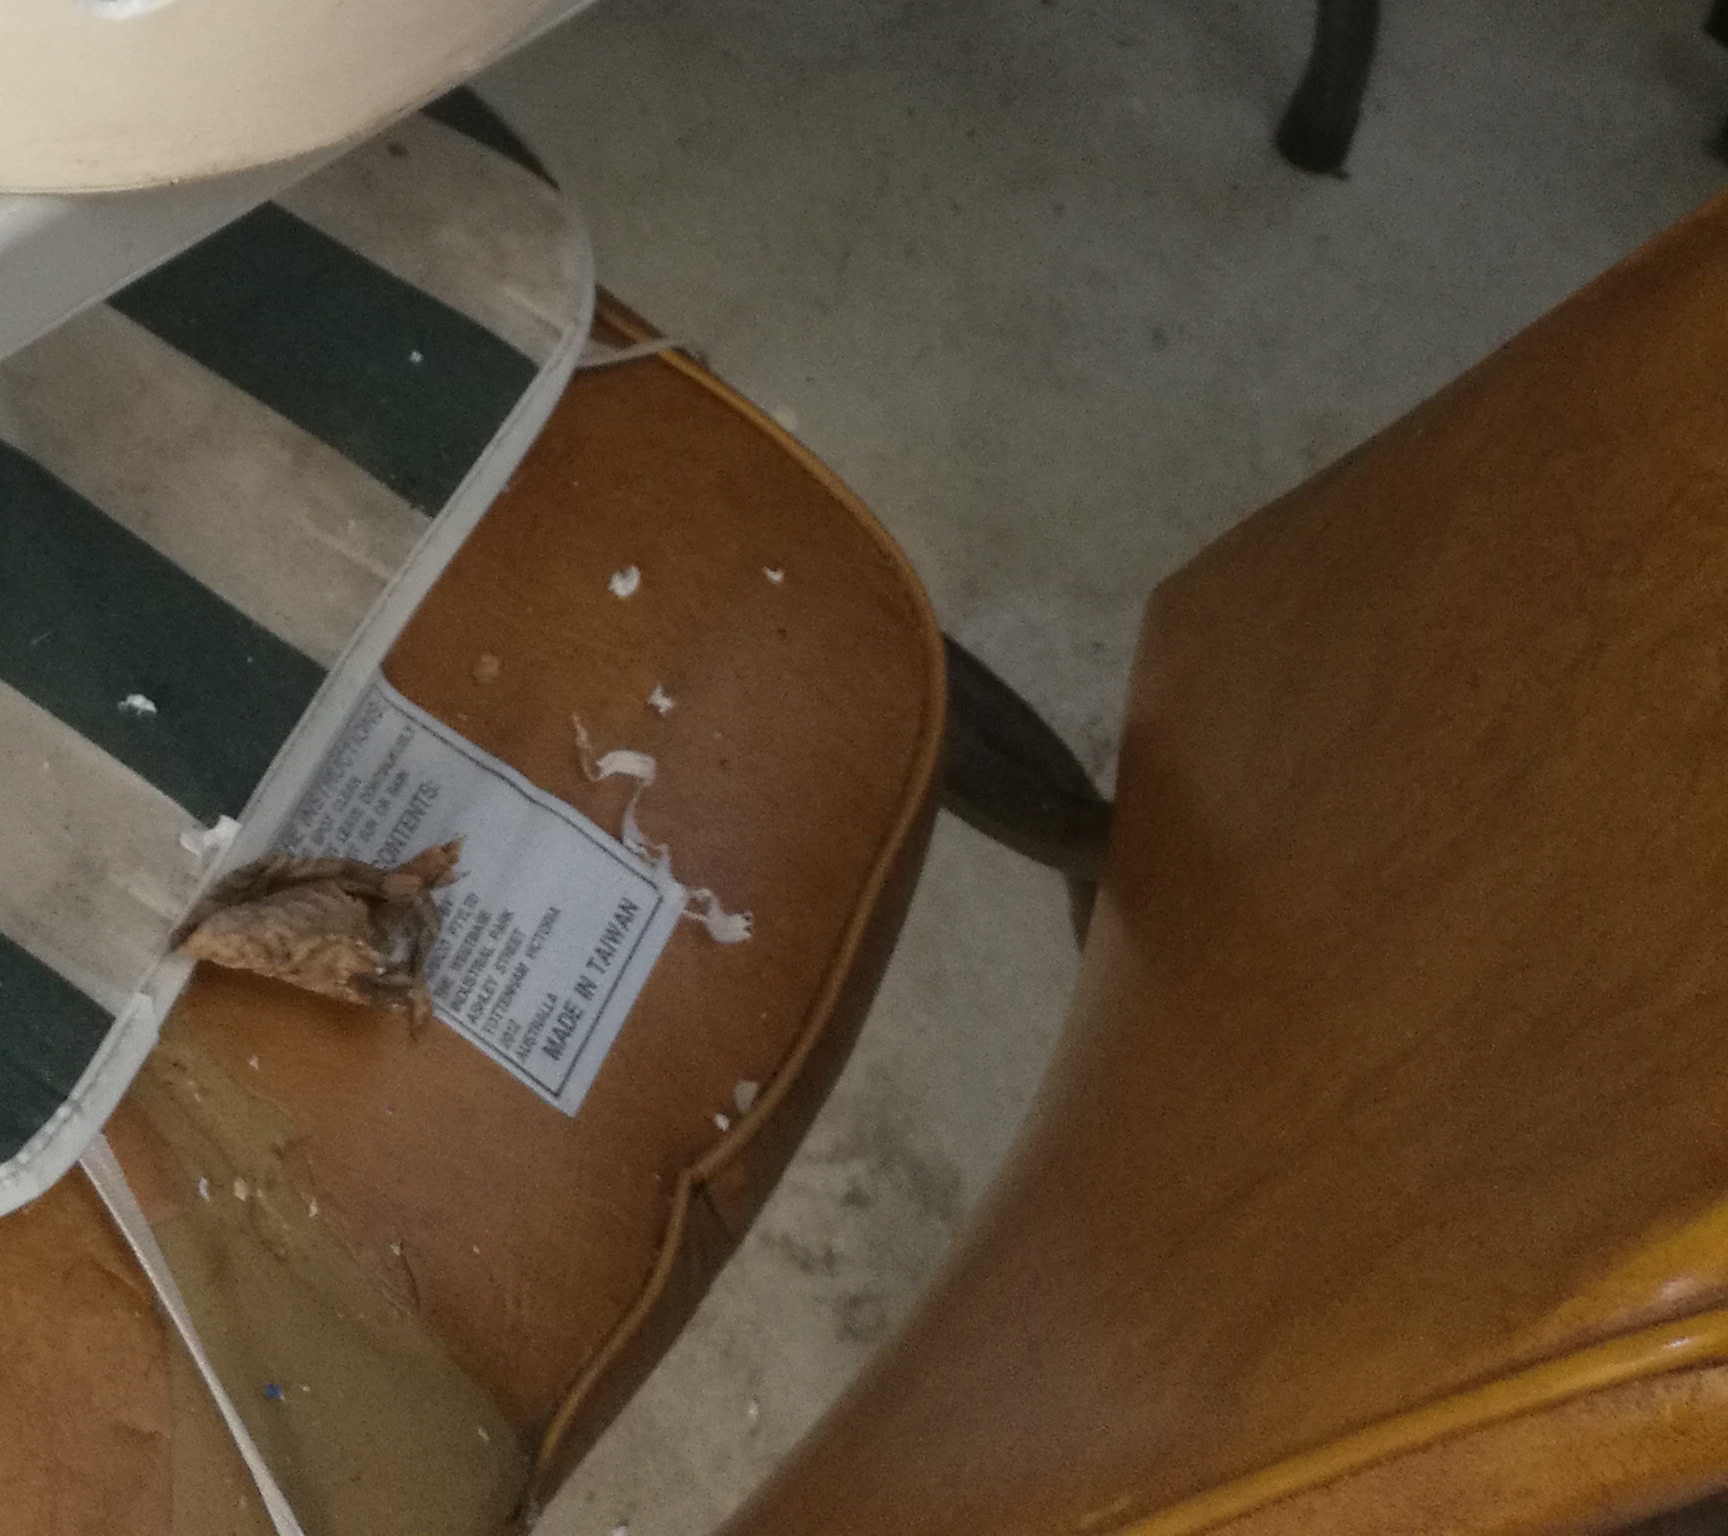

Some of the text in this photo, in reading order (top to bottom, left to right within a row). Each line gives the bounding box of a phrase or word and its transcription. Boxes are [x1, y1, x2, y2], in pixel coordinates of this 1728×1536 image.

[537, 896, 639, 1060] MADE IN TAIWAN
